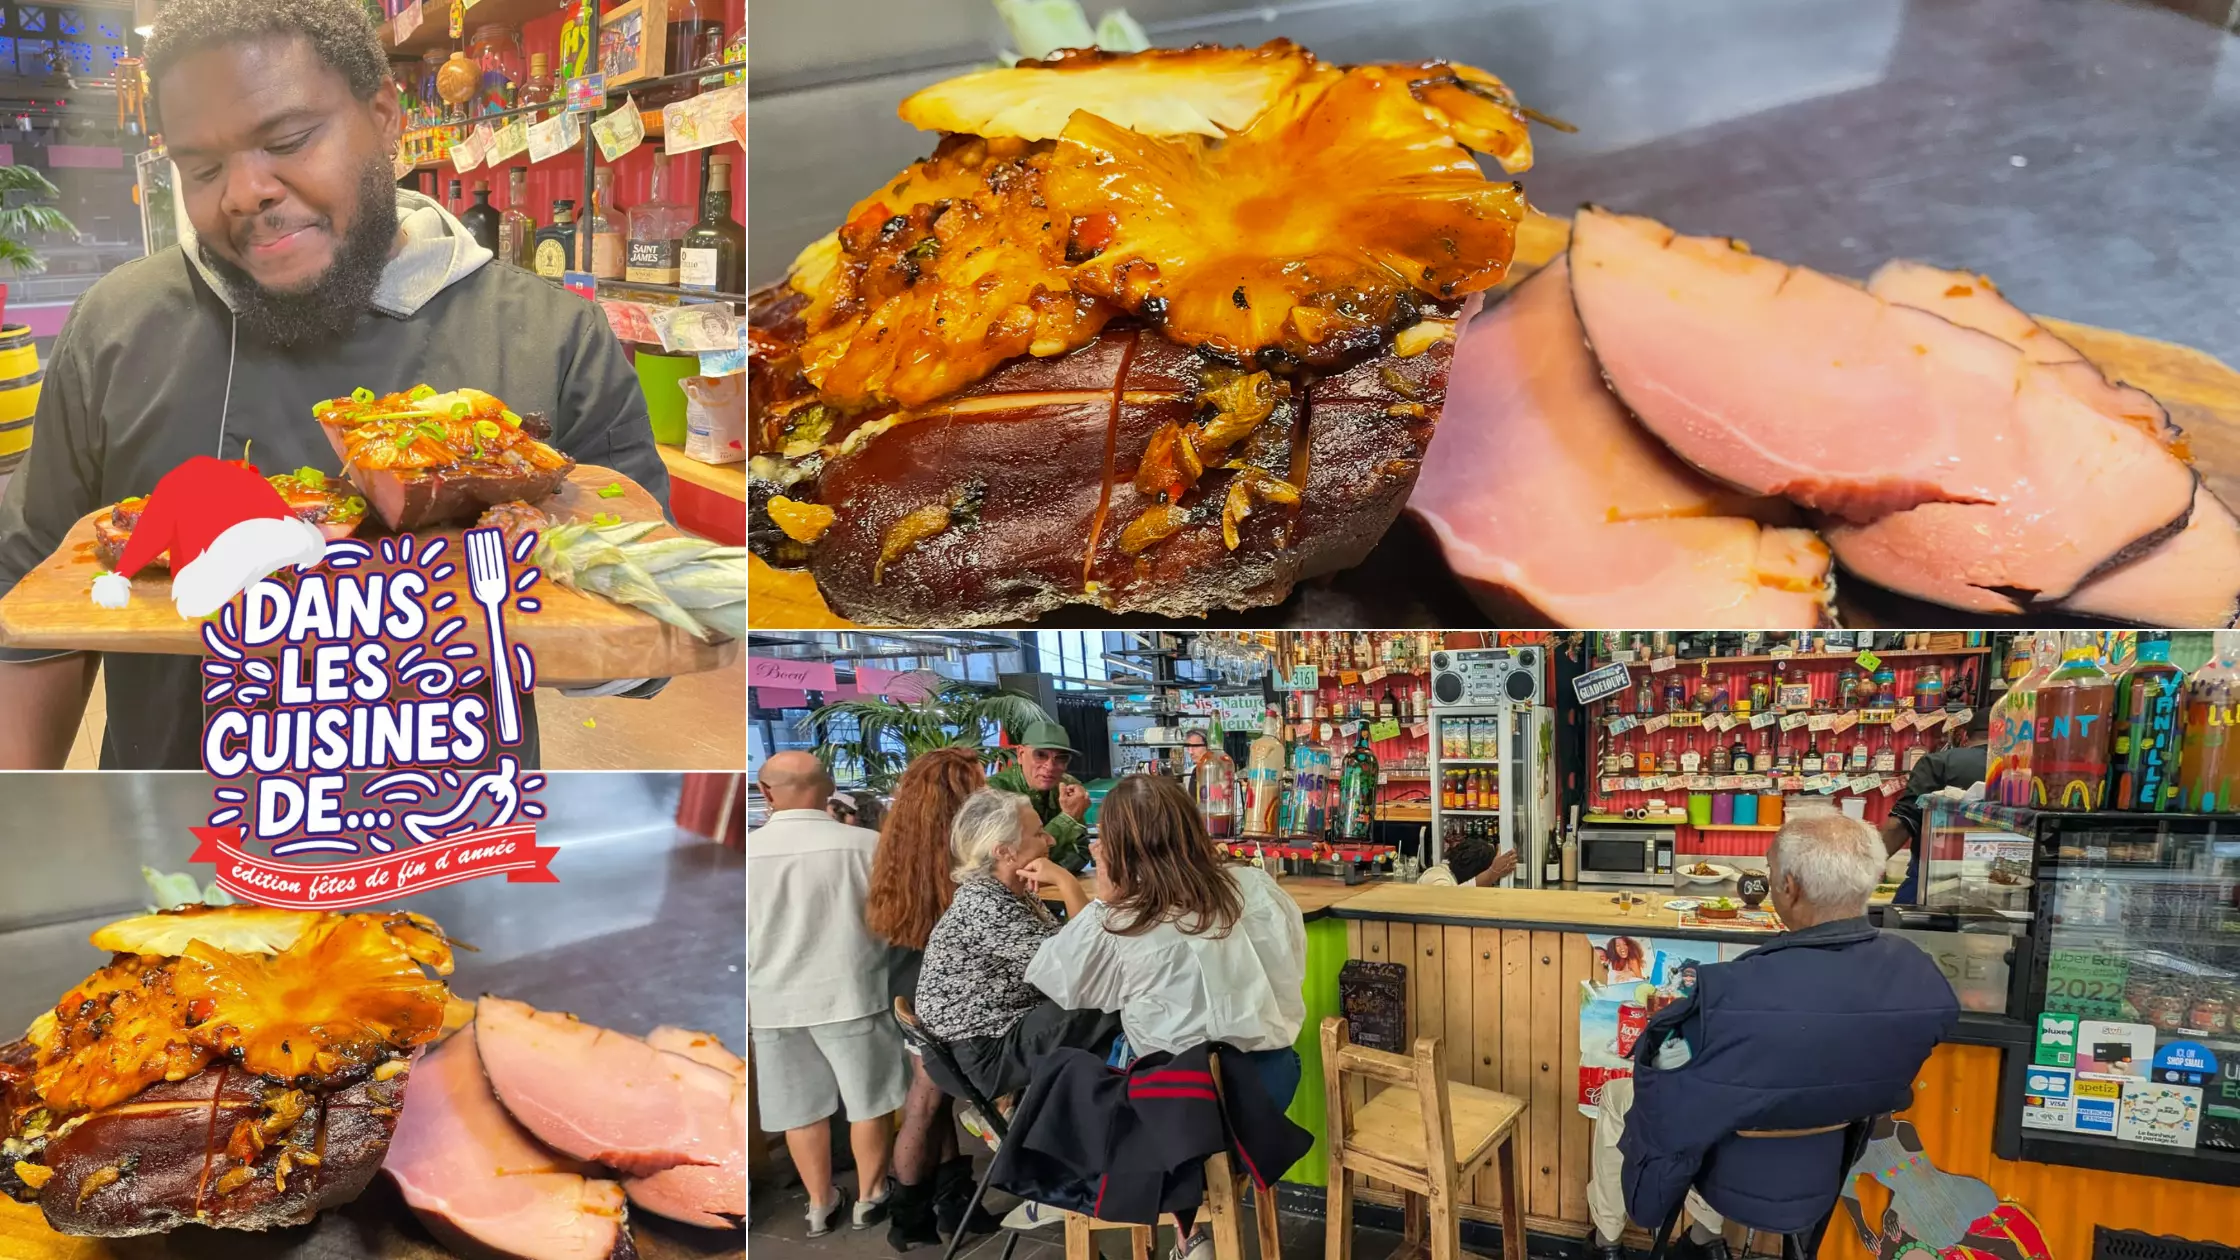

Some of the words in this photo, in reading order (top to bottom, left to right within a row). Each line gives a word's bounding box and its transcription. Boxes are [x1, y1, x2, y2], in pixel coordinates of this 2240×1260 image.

[632, 244, 659, 254] SAINT
[630, 253, 659, 263] JAMES
[1579, 672, 1628, 700] GUADELOUPE
[2140, 670, 2184, 803] VANILLE
[2052, 951, 2089, 965] Uber
[2091, 954, 2128, 969] Eats
[2047, 976, 2122, 1003] 2022
[2042, 1026, 2074, 1036] pluxee
[2166, 1056, 2184, 1066] SHOP
[2185, 1058, 2205, 1069] SMALL
[2078, 1083, 2115, 1093] apetiz
[2077, 1108, 2112, 1117] AMERICAN
[2143, 1135, 2170, 1144] partage
[2146, 1130, 2176, 1139] bonheur
